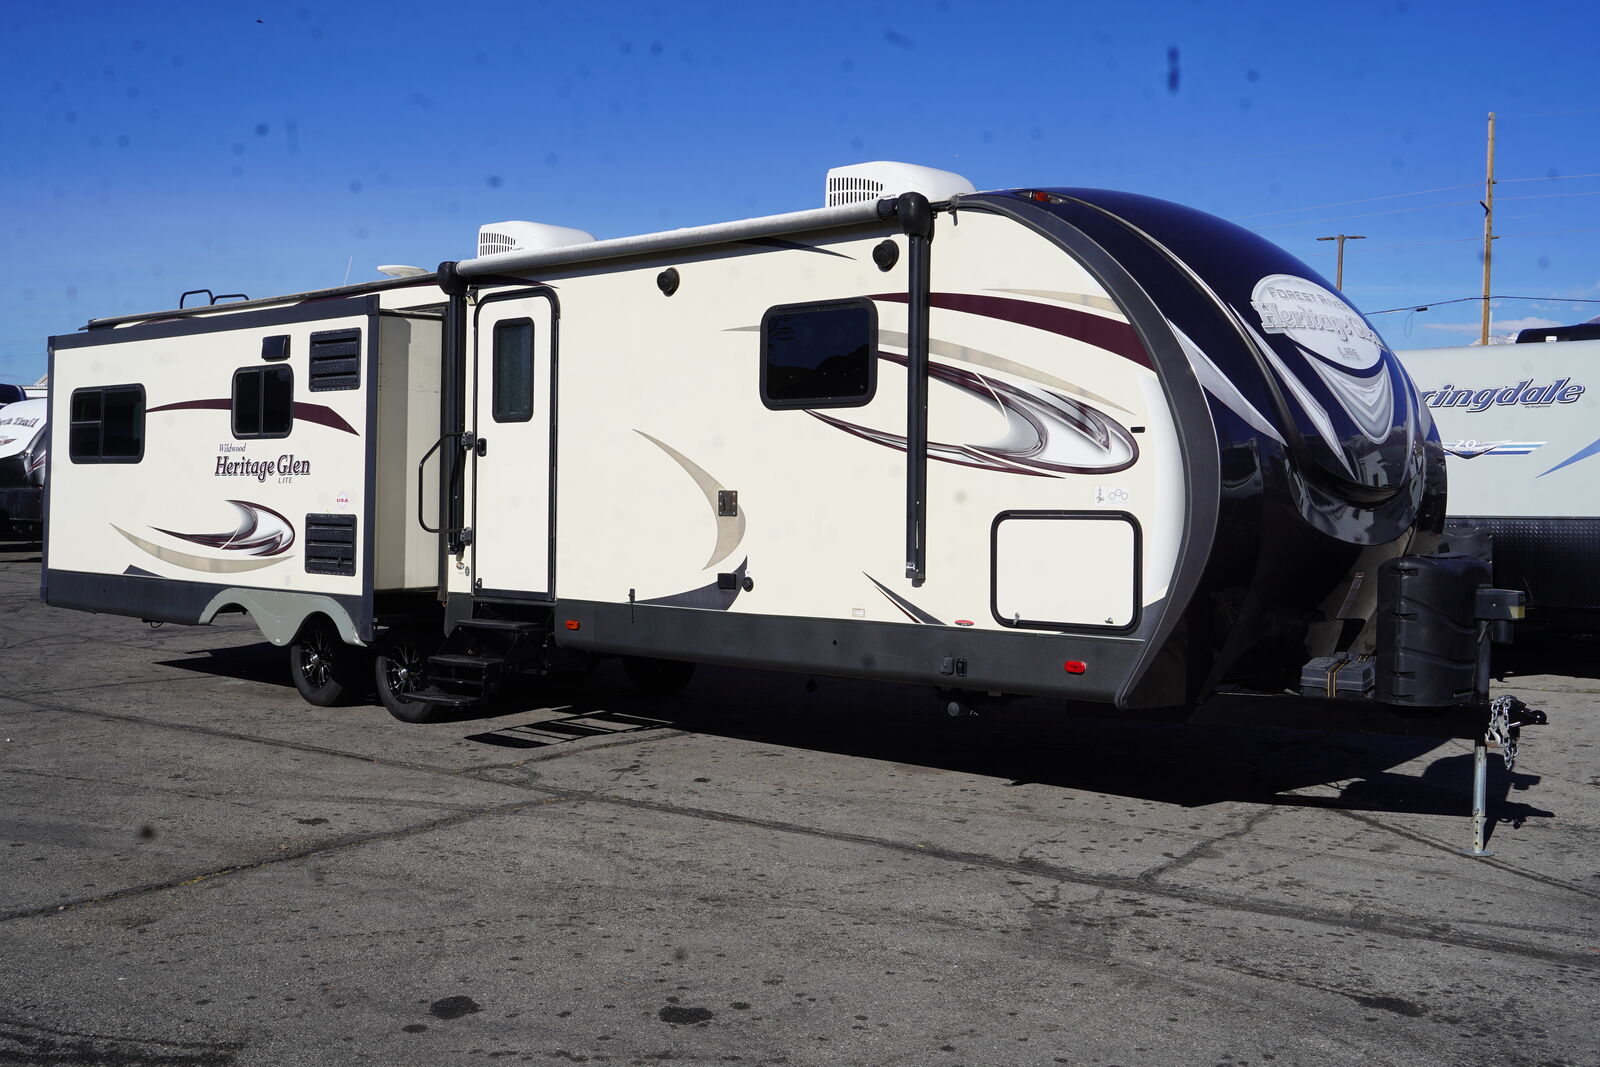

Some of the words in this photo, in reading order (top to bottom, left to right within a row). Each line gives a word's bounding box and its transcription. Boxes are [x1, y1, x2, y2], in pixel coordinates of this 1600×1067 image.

[1267, 286, 1317, 303] FOREST
[219, 442, 247, 453] Wildwood
[214, 456, 275, 483] Heritage
[277, 454, 310, 475] Glen
